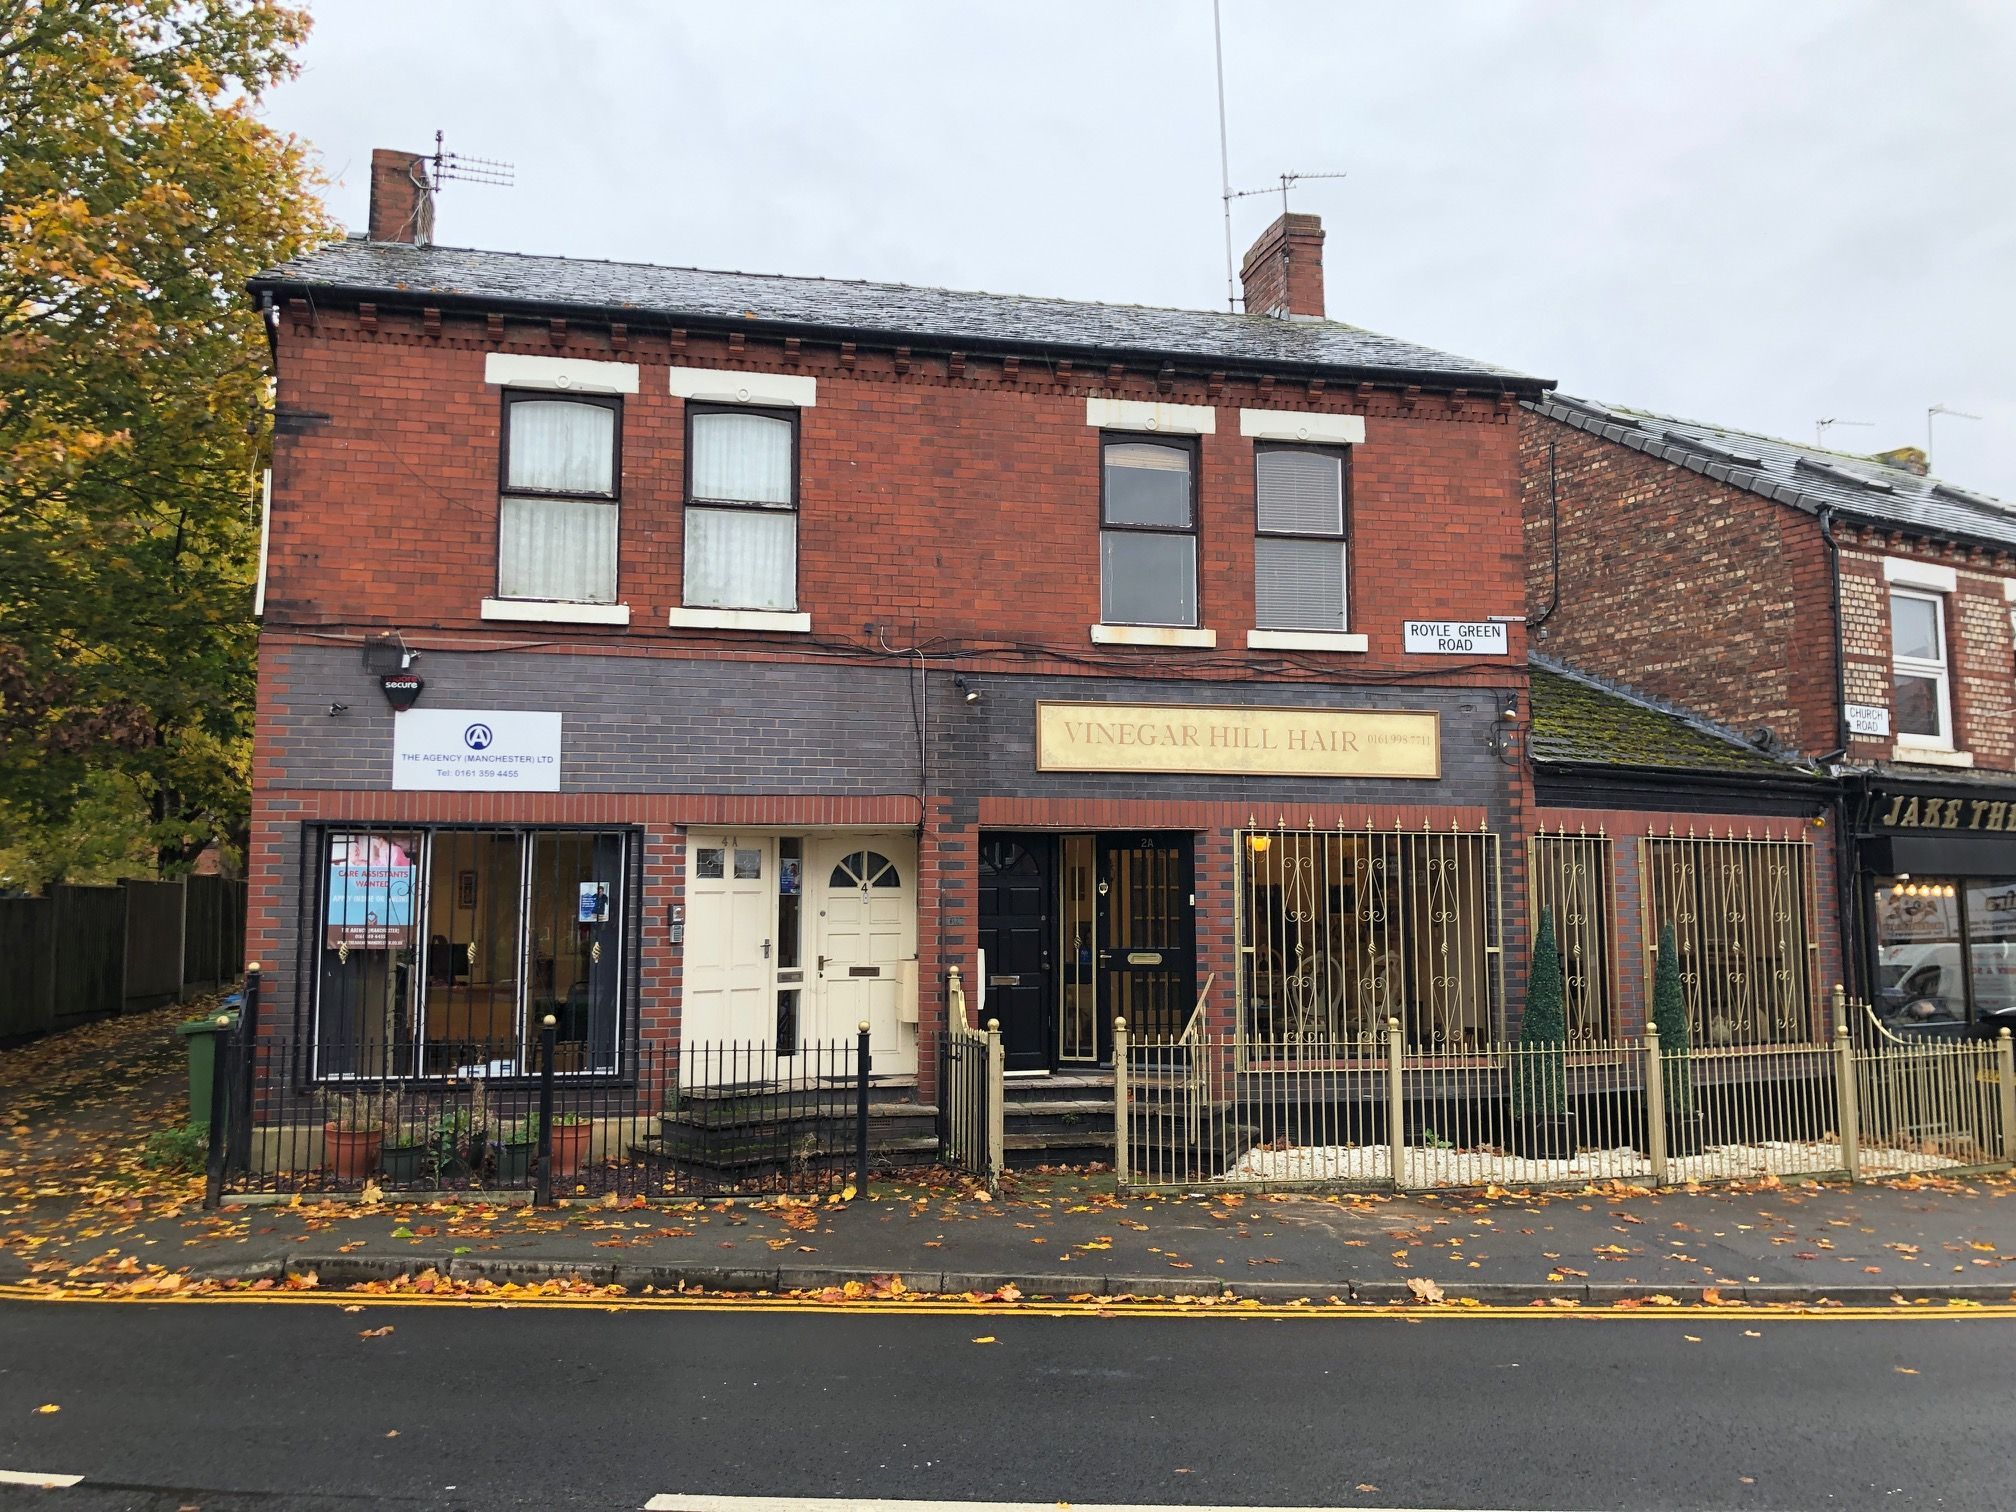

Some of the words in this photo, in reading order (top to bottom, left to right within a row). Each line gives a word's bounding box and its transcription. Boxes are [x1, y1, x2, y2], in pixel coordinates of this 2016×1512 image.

[1411, 624, 1451, 637] ROYLE
[1458, 624, 1501, 638] GREEN
[1438, 638, 1473, 651] ROAD
[385, 681, 418, 689] secure
[1849, 707, 1883, 720] CHURCH
[1856, 720, 1879, 732] ROAD
[1064, 721, 1200, 748] VINEGAR
[1209, 726, 1278, 750] HILL
[1287, 728, 1360, 753] HAIR
[402, 753, 420, 761] THE
[422, 753, 461, 762] AGENCY
[464, 754, 535, 764] (MANCHESTER)
[537, 755, 554, 763] LTD
[454, 769, 476, 777] 0161
[479, 770, 495, 778] 359
[497, 770, 519, 778] 4455
[1883, 795, 1963, 829] JAKE
[1141, 838, 1154, 848] 2A
[860, 882, 868, 893] 4
